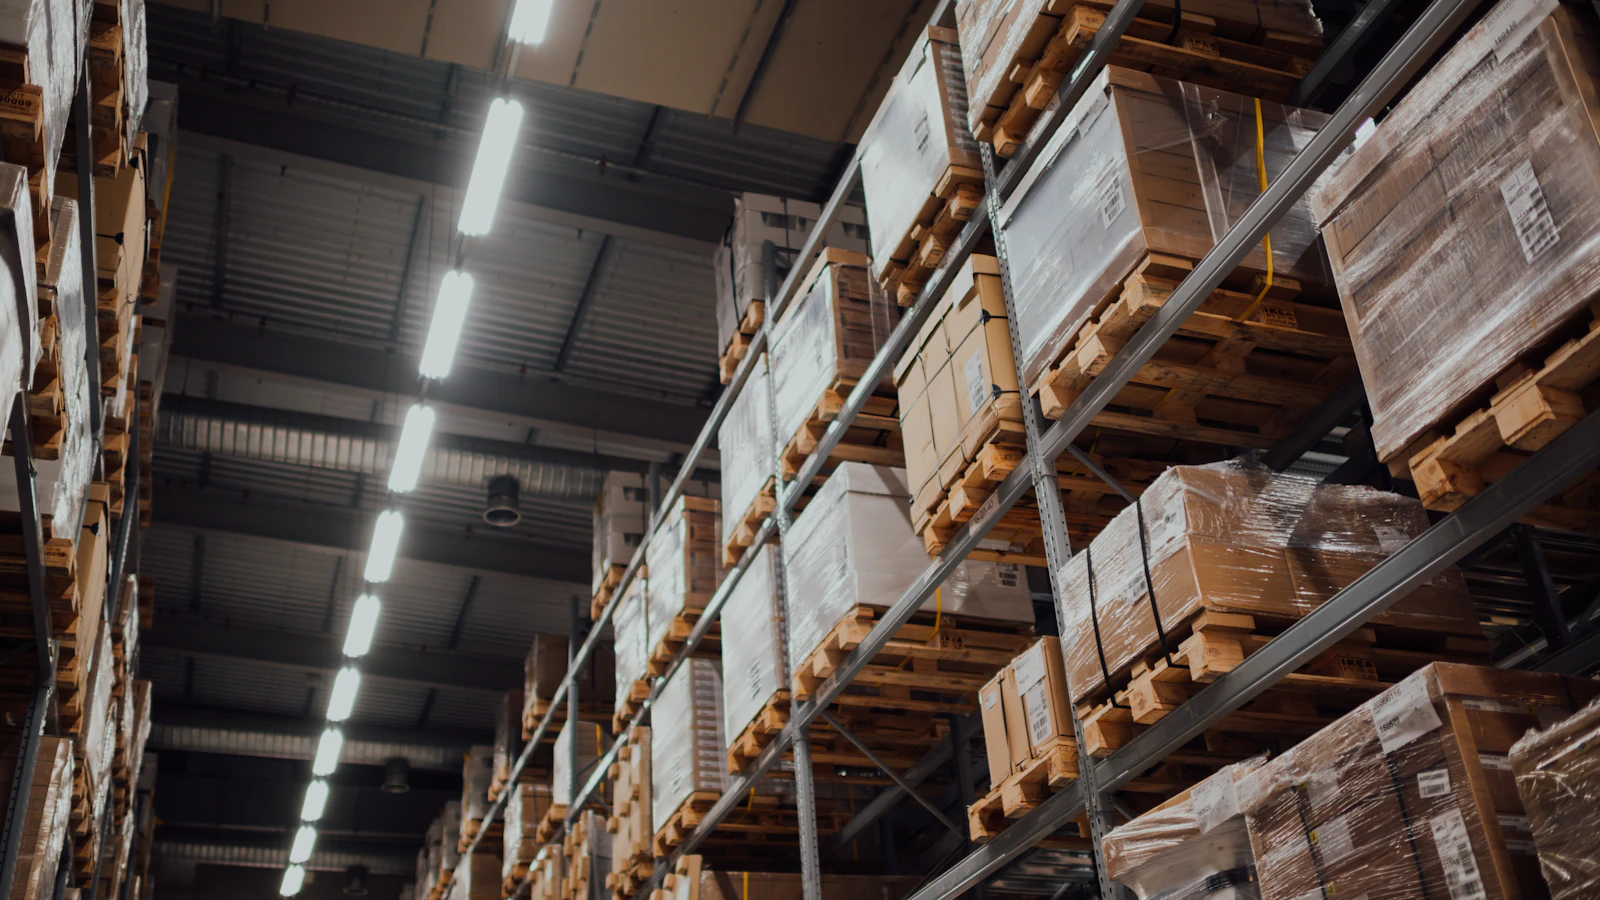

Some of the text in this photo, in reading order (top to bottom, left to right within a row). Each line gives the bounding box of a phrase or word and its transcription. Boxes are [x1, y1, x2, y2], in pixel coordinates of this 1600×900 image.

[1341, 658, 1373, 668] IKEA
[1373, 687, 1402, 711] 20366116
[1379, 716, 1401, 733] 160520
